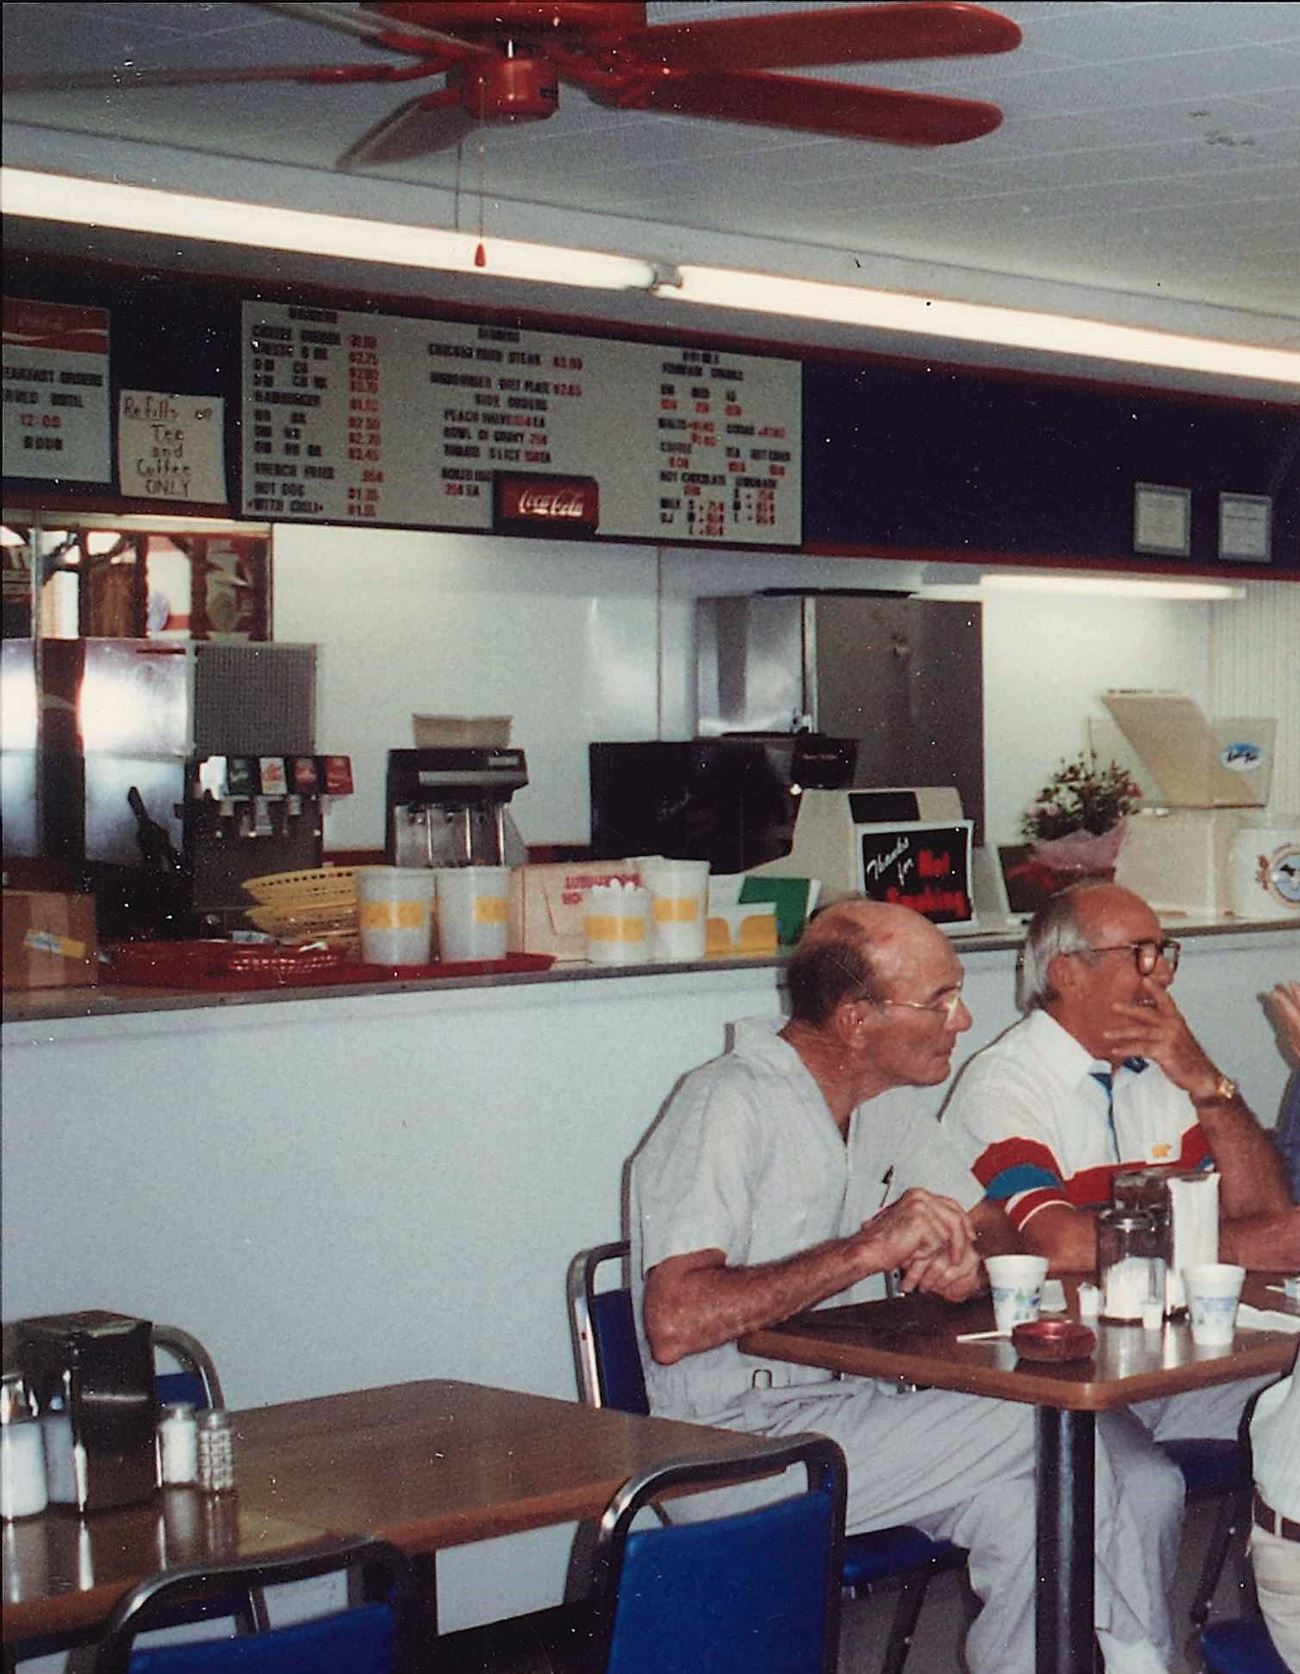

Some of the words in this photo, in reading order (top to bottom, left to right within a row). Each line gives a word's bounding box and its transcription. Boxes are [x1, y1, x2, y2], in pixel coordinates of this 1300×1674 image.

[137, 458, 192, 477] Coffee
[255, 462, 297, 477] FRENCH
[146, 478, 191, 497] ONLY
[255, 481, 276, 495] HOT
